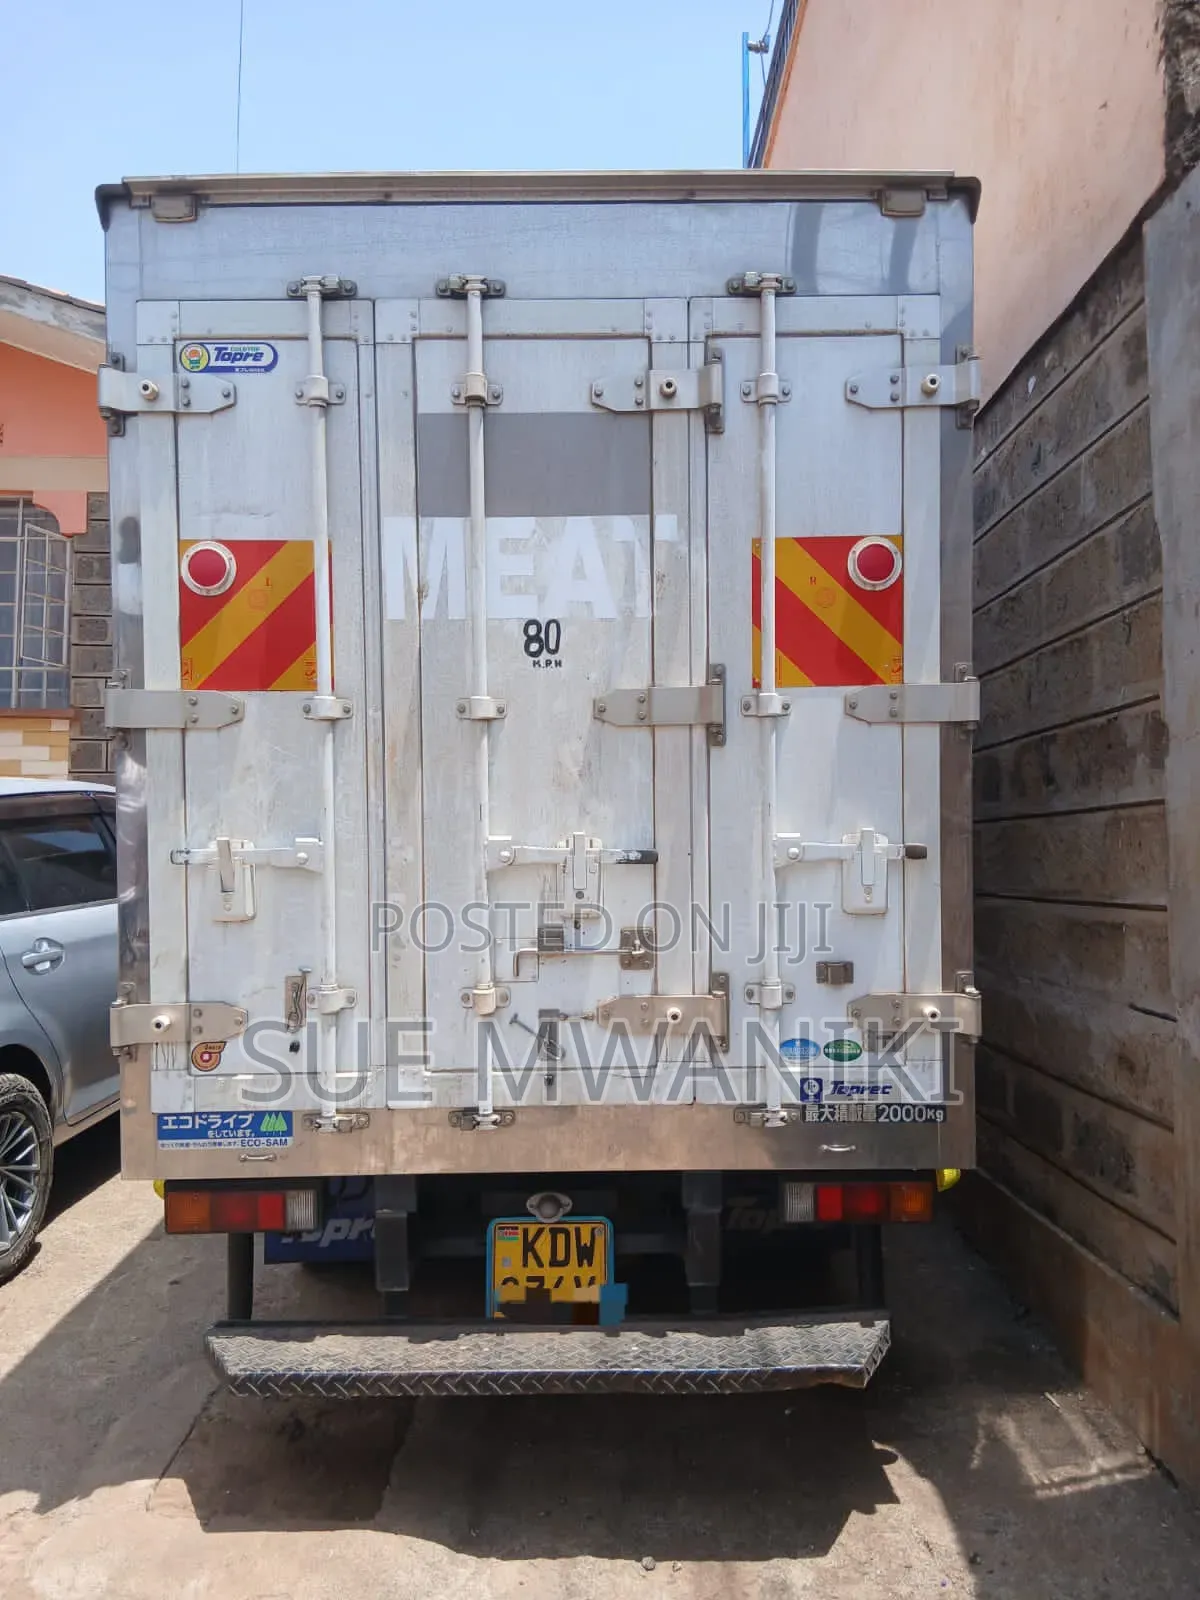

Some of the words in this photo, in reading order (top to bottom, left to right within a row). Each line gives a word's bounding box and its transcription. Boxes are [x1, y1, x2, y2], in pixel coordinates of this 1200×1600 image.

[523, 619, 561, 658] 80
[161, 1113, 255, 1129] エコドライブ
[240, 1138, 288, 1148] ECO-SAM
[522, 1226, 597, 1268] KDW
